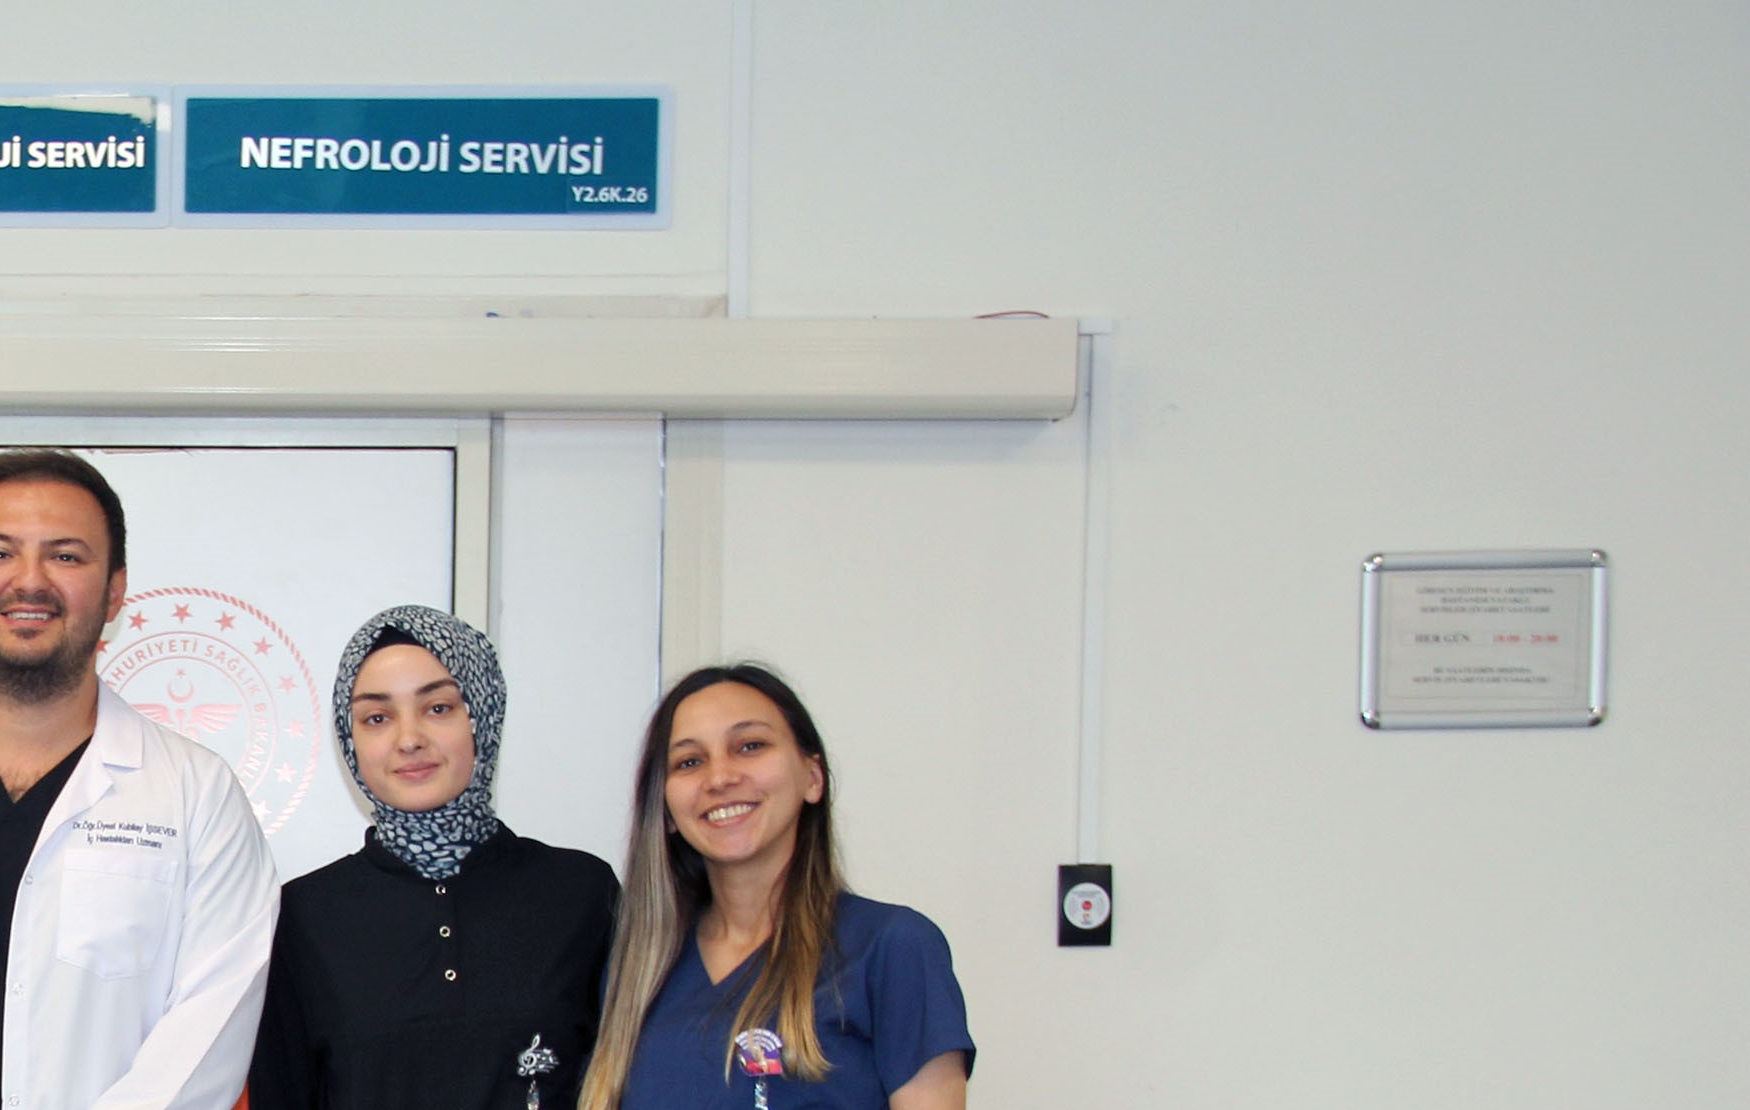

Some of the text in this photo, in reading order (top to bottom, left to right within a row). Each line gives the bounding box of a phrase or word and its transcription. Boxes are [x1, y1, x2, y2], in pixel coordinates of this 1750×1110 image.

[26, 135, 146, 169] SERVİSİ
[239, 134, 604, 176] NEFROLOJİ SERVİSİ
[570, 186, 649, 204] Y2.6K.26
